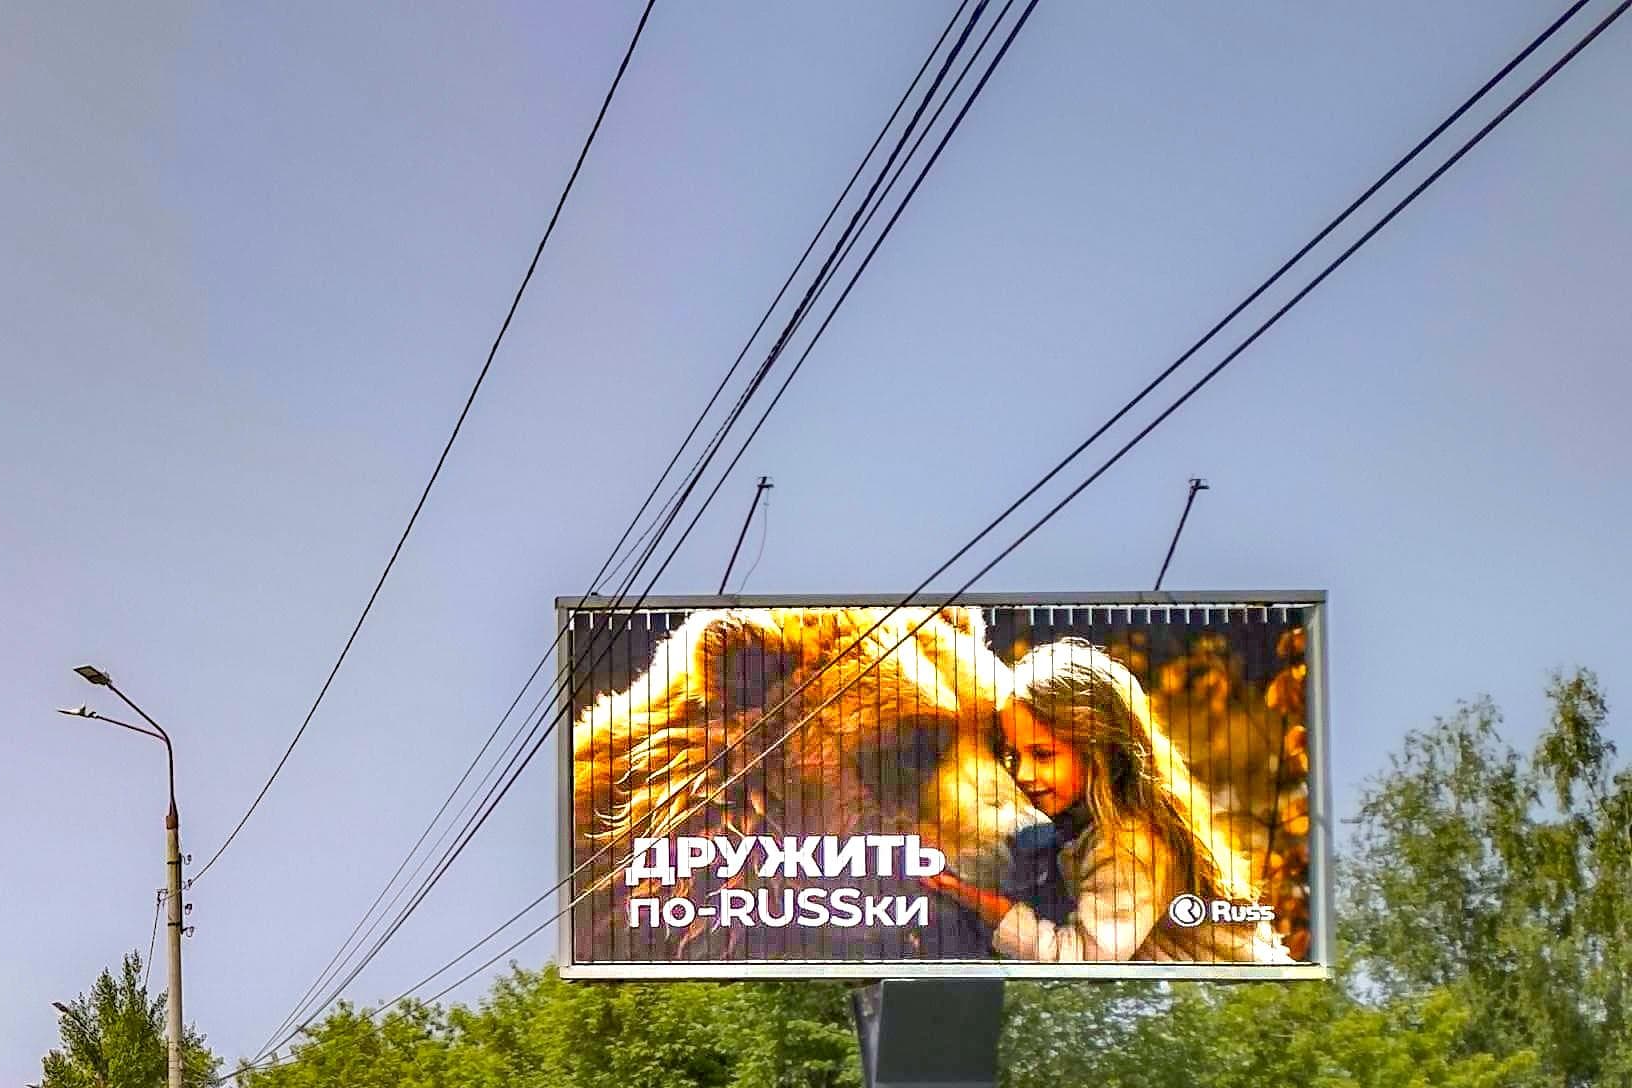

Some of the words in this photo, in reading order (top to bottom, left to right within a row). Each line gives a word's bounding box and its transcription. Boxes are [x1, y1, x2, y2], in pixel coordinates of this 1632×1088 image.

[625, 835, 946, 886] ДРУЖИТЬ
[629, 888, 929, 928] по-RUSSки
[1211, 899, 1275, 922] Russ
